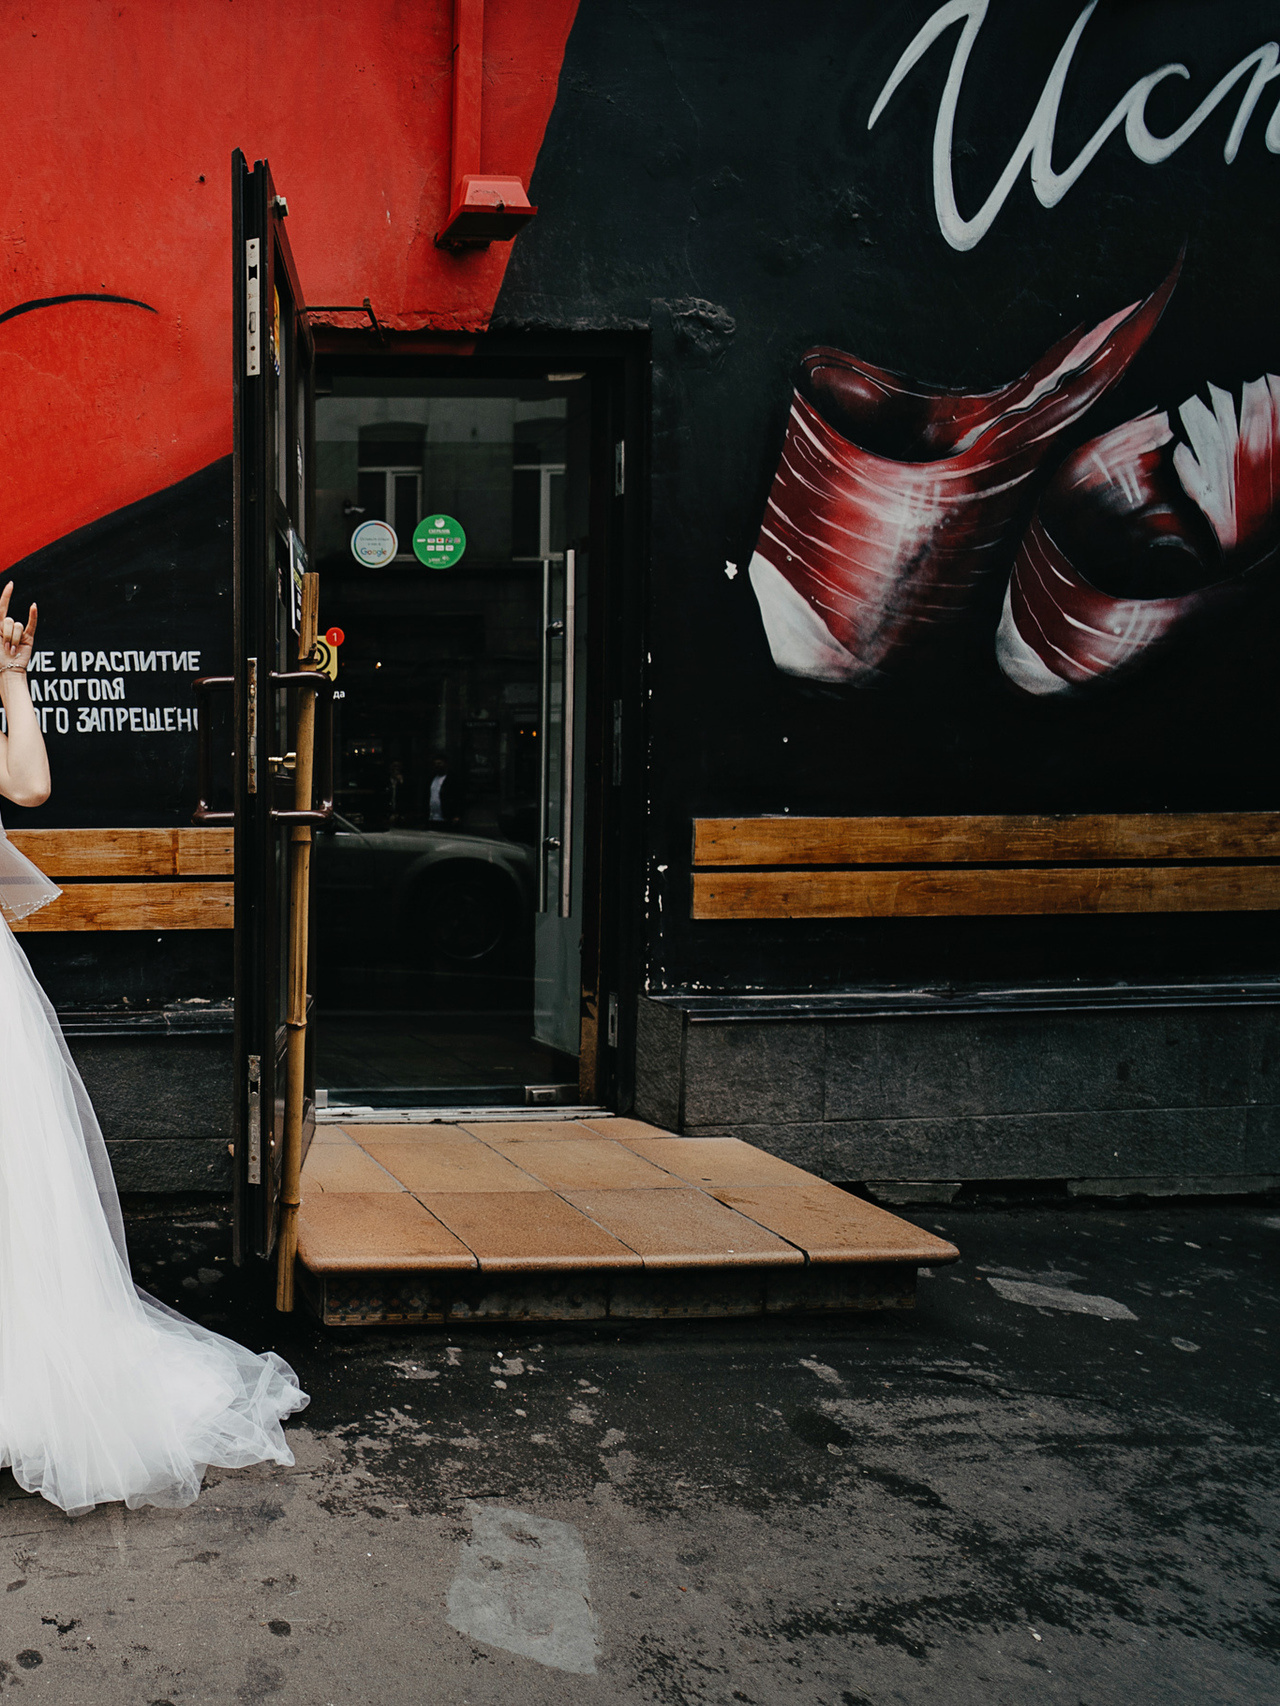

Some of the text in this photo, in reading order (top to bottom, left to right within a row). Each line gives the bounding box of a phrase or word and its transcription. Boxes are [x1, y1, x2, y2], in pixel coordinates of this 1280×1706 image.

[361, 548, 387, 557] Google
[332, 632, 337, 642] 1
[61, 651, 78, 673] И
[81, 651, 201, 673] РАСПИТИЕ
[30, 678, 126, 702] ЛКОГОЛЯ
